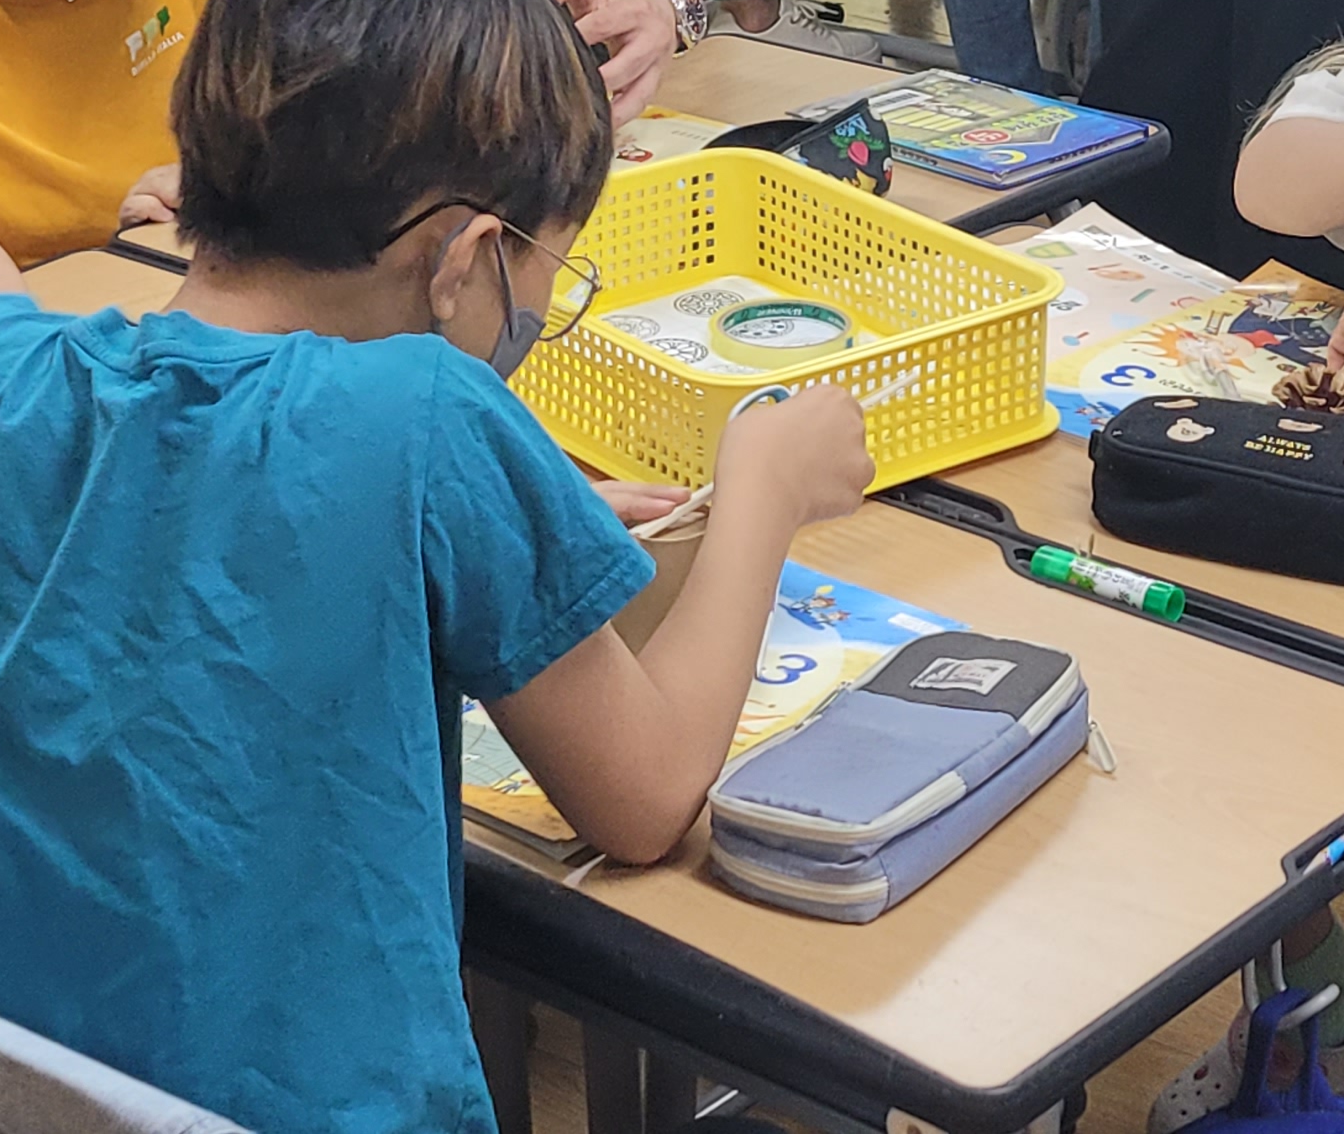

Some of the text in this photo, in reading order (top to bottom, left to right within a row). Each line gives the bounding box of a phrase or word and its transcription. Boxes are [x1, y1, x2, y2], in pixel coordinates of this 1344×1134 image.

[1101, 365, 1156, 387] 3
[1256, 434, 1312, 451] ALWAYS
[1264, 445, 1314, 461] HAPPY
[755, 653, 818, 685] 3
